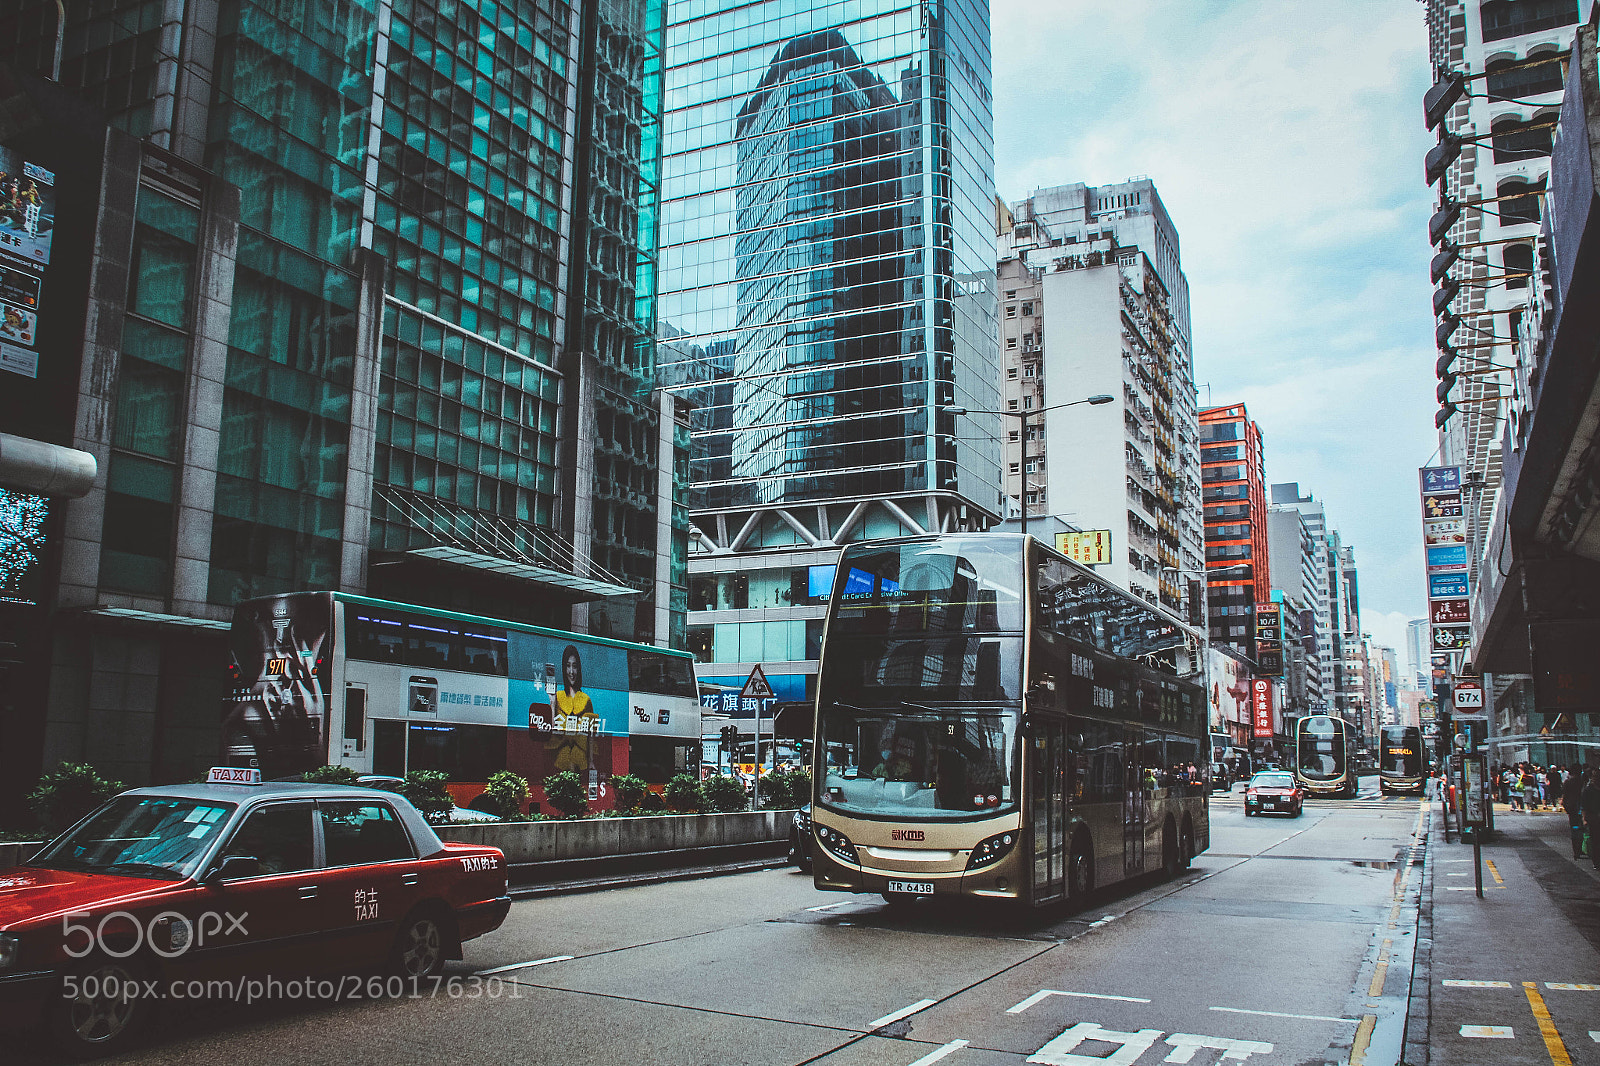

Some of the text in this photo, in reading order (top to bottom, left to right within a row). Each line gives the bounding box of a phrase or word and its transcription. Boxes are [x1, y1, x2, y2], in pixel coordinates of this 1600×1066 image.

[1259, 618, 1277, 626] 10/F
[269, 659, 285, 675] 971
[212, 768, 252, 782] TAXI
[900, 830, 925, 842] KMB
[460, 856, 498, 873] TAXI 的士
[354, 887, 378, 903] 的士
[890, 882, 932, 893] TR 6438
[354, 903, 378, 921] TAXI
